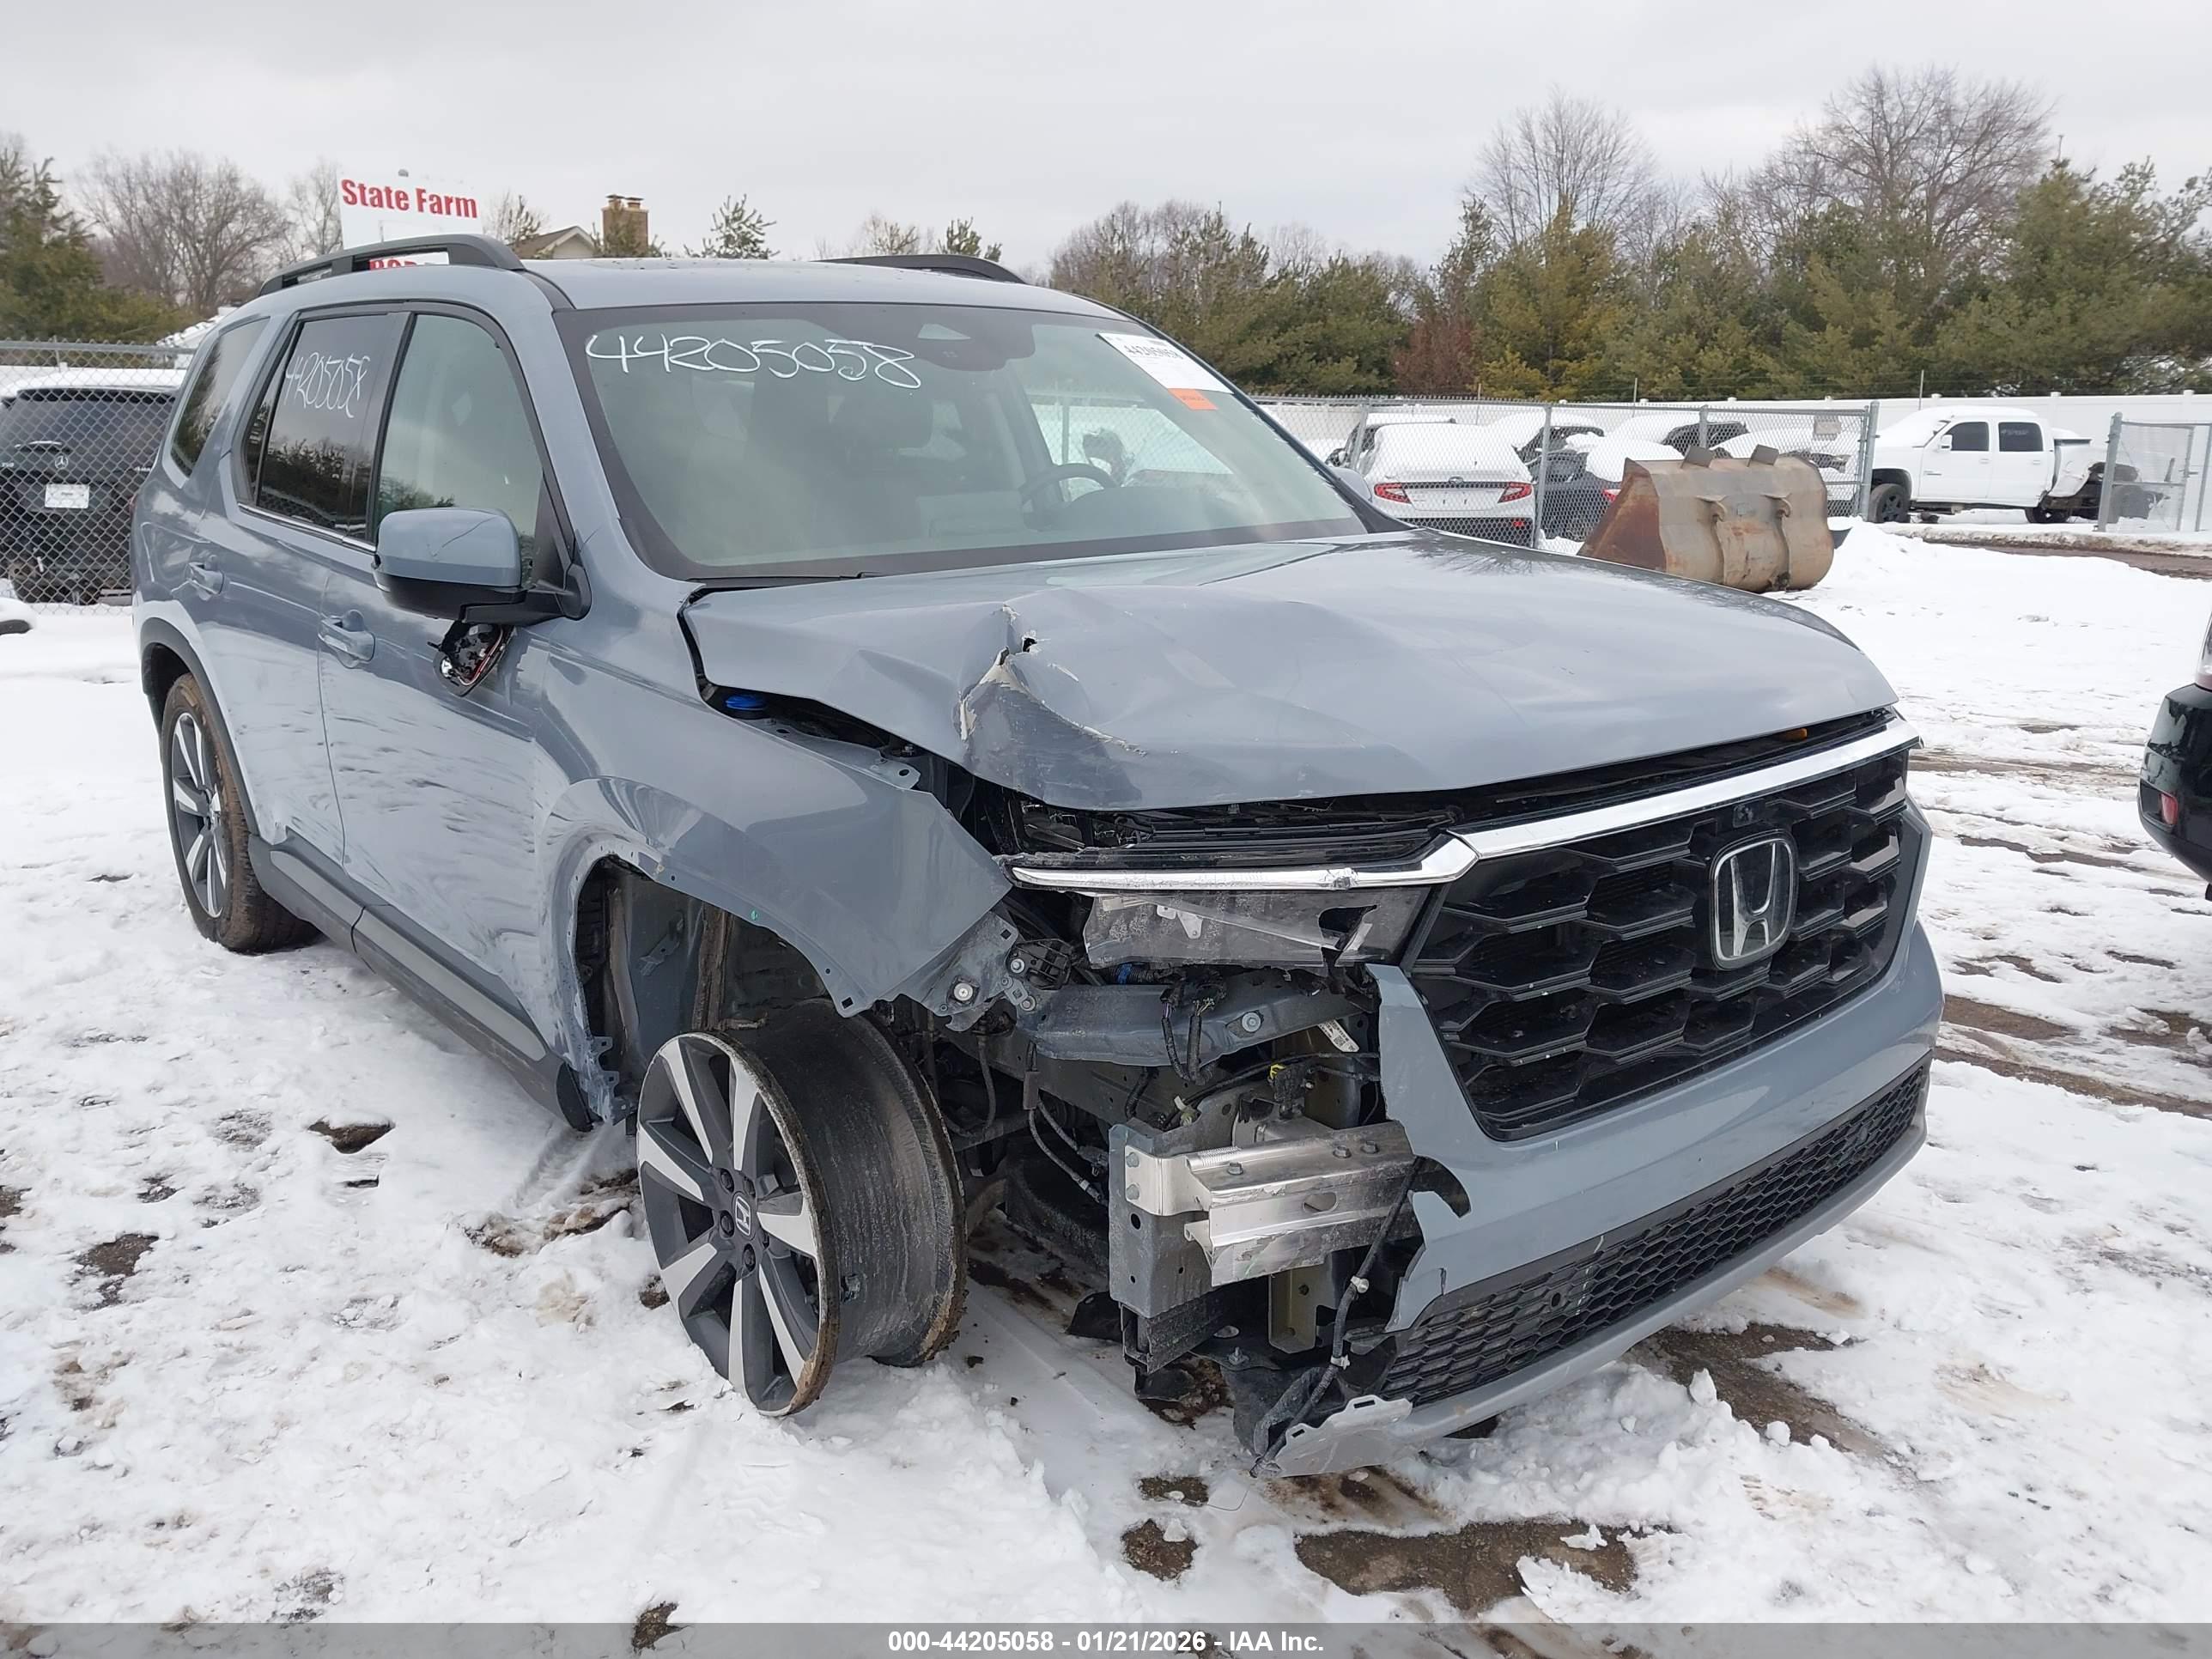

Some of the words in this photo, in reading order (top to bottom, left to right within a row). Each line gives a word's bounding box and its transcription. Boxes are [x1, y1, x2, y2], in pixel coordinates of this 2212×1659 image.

[341, 179, 410, 211] State
[415, 187, 478, 219] Farm
[586, 333, 921, 388] 44205058
